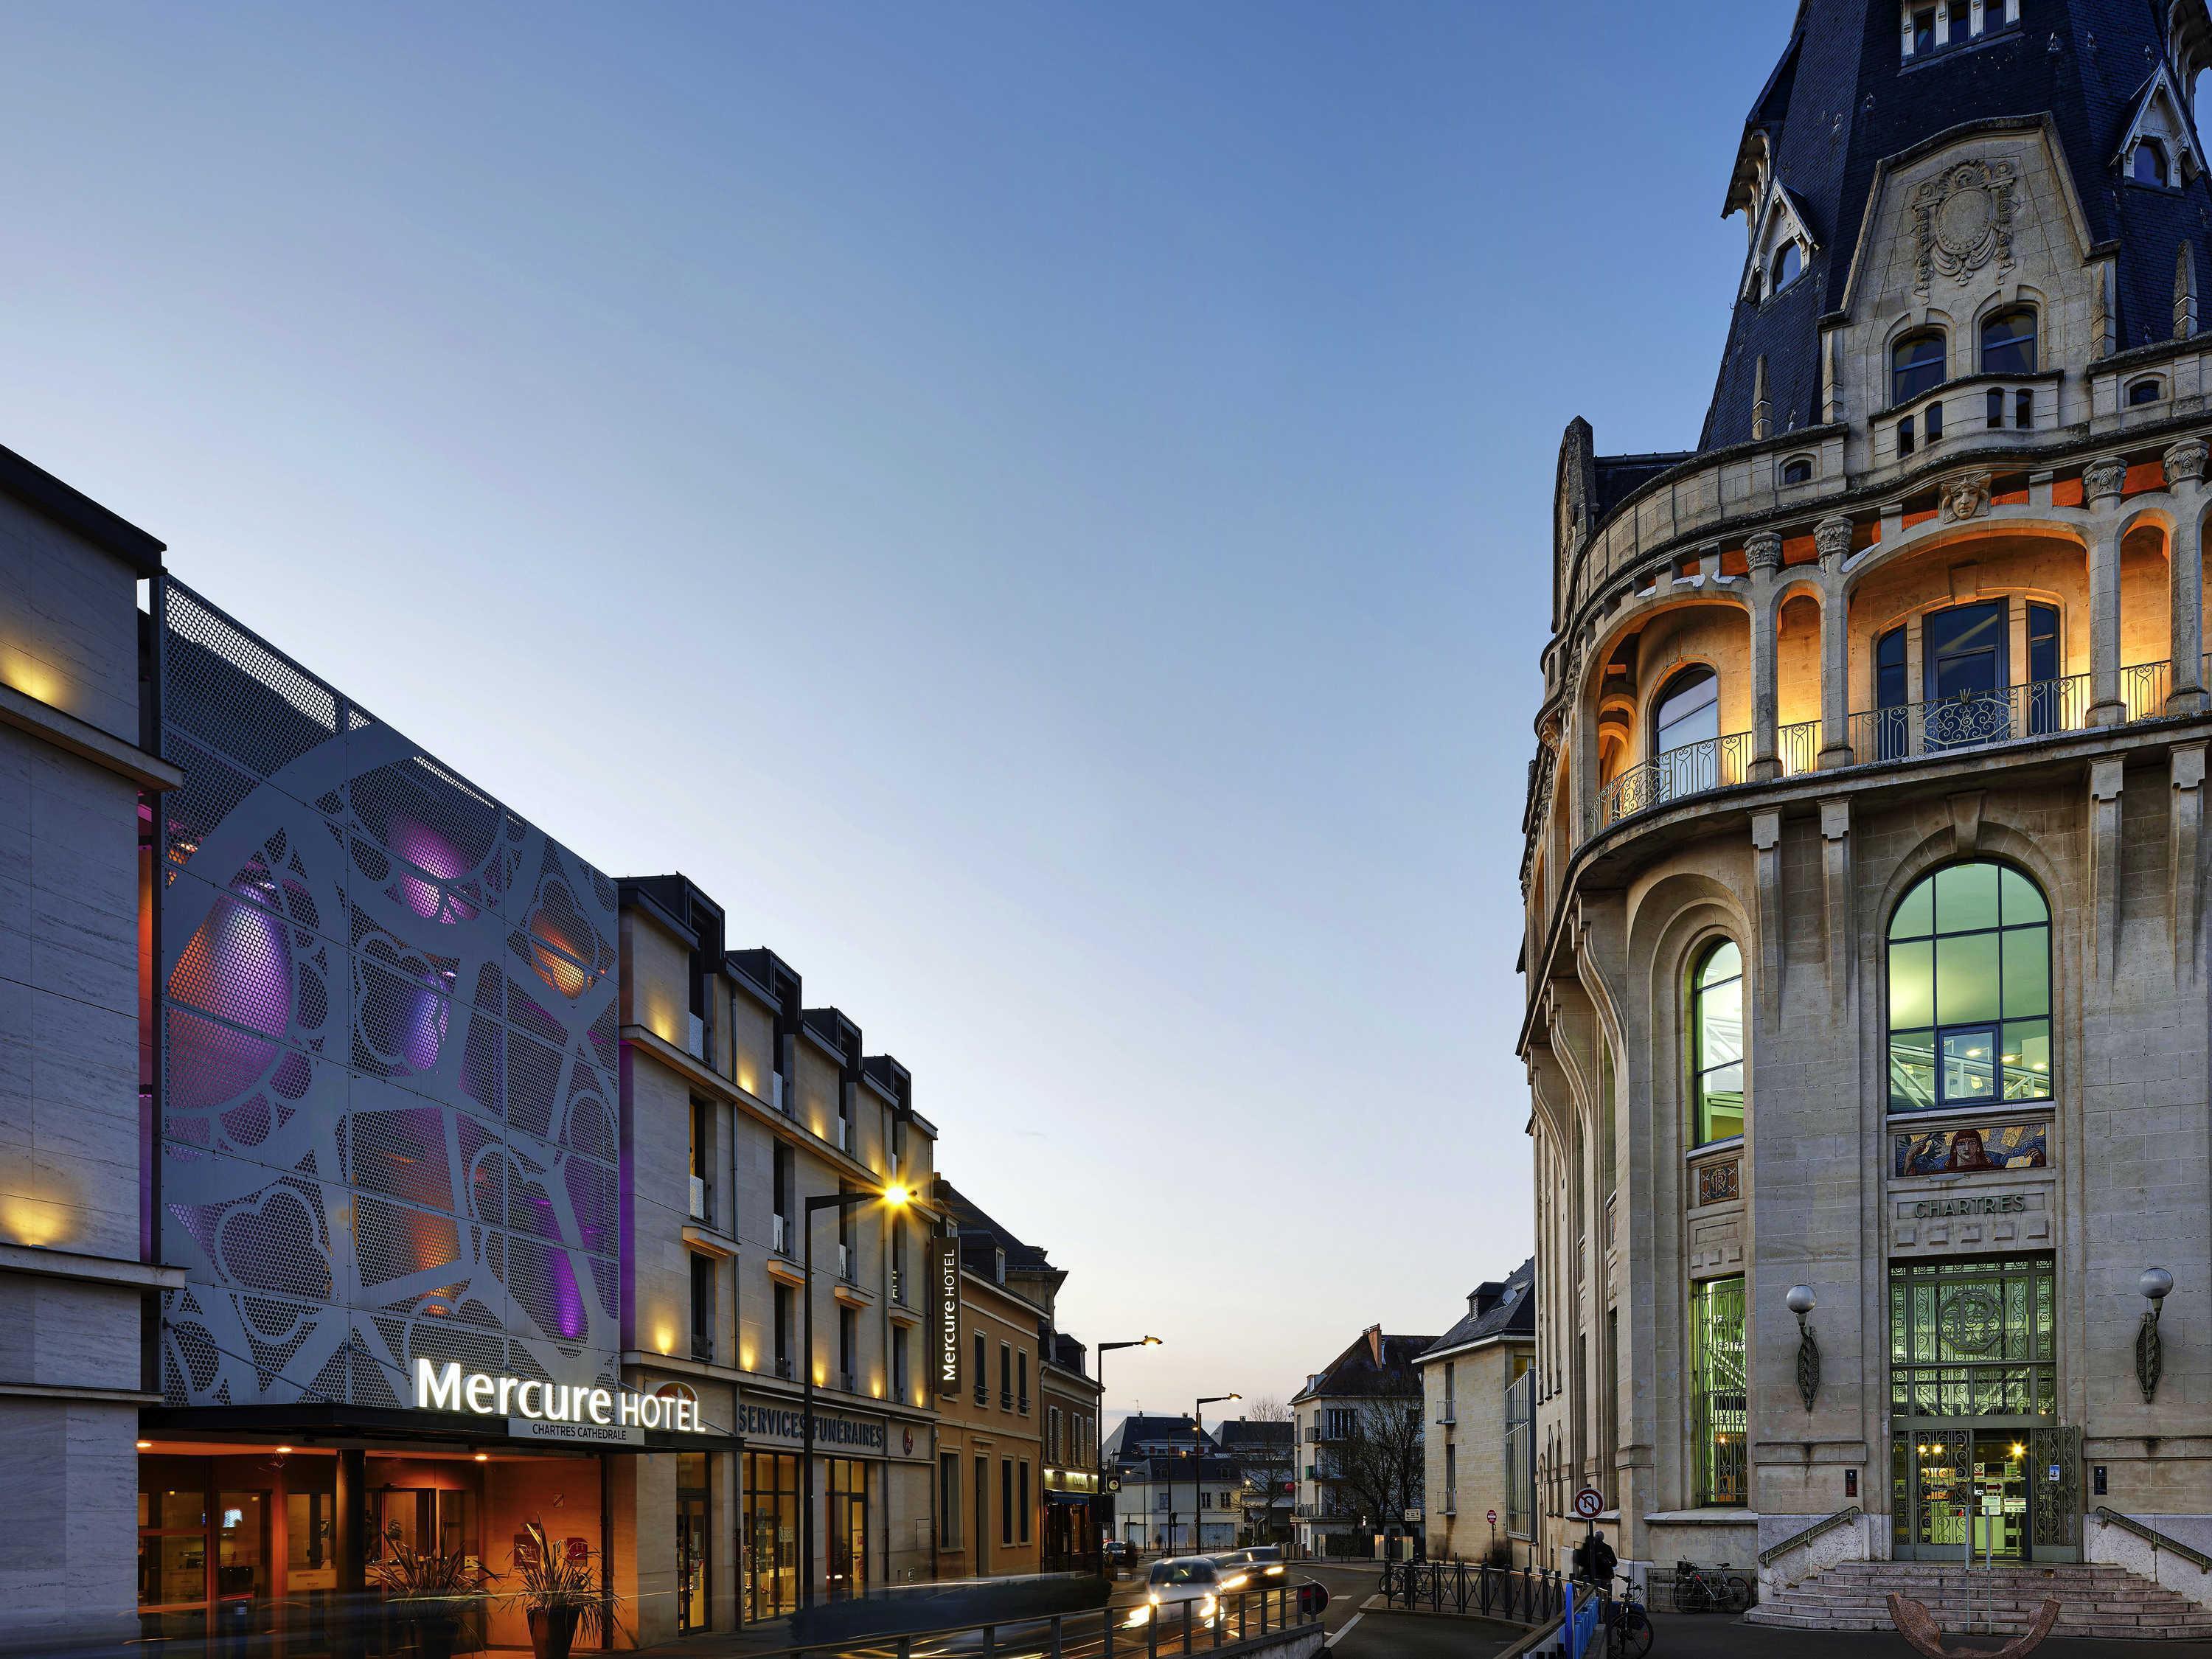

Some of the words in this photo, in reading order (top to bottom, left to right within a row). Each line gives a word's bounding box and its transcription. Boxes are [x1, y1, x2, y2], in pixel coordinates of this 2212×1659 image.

[1915, 1195, 2025, 1218] CHARTRES
[944, 1249, 955, 1296] HOTEL
[943, 1300, 955, 1381] Mercure
[412, 1358, 612, 1424] Mercure
[620, 1392, 706, 1432] HOTEL
[532, 1424, 576, 1437] CHARTRES
[577, 1427, 627, 1440] CATHEDRALE
[739, 1403, 805, 1439] SERVICES
[813, 1415, 882, 1447] FUNÉRAIRES
